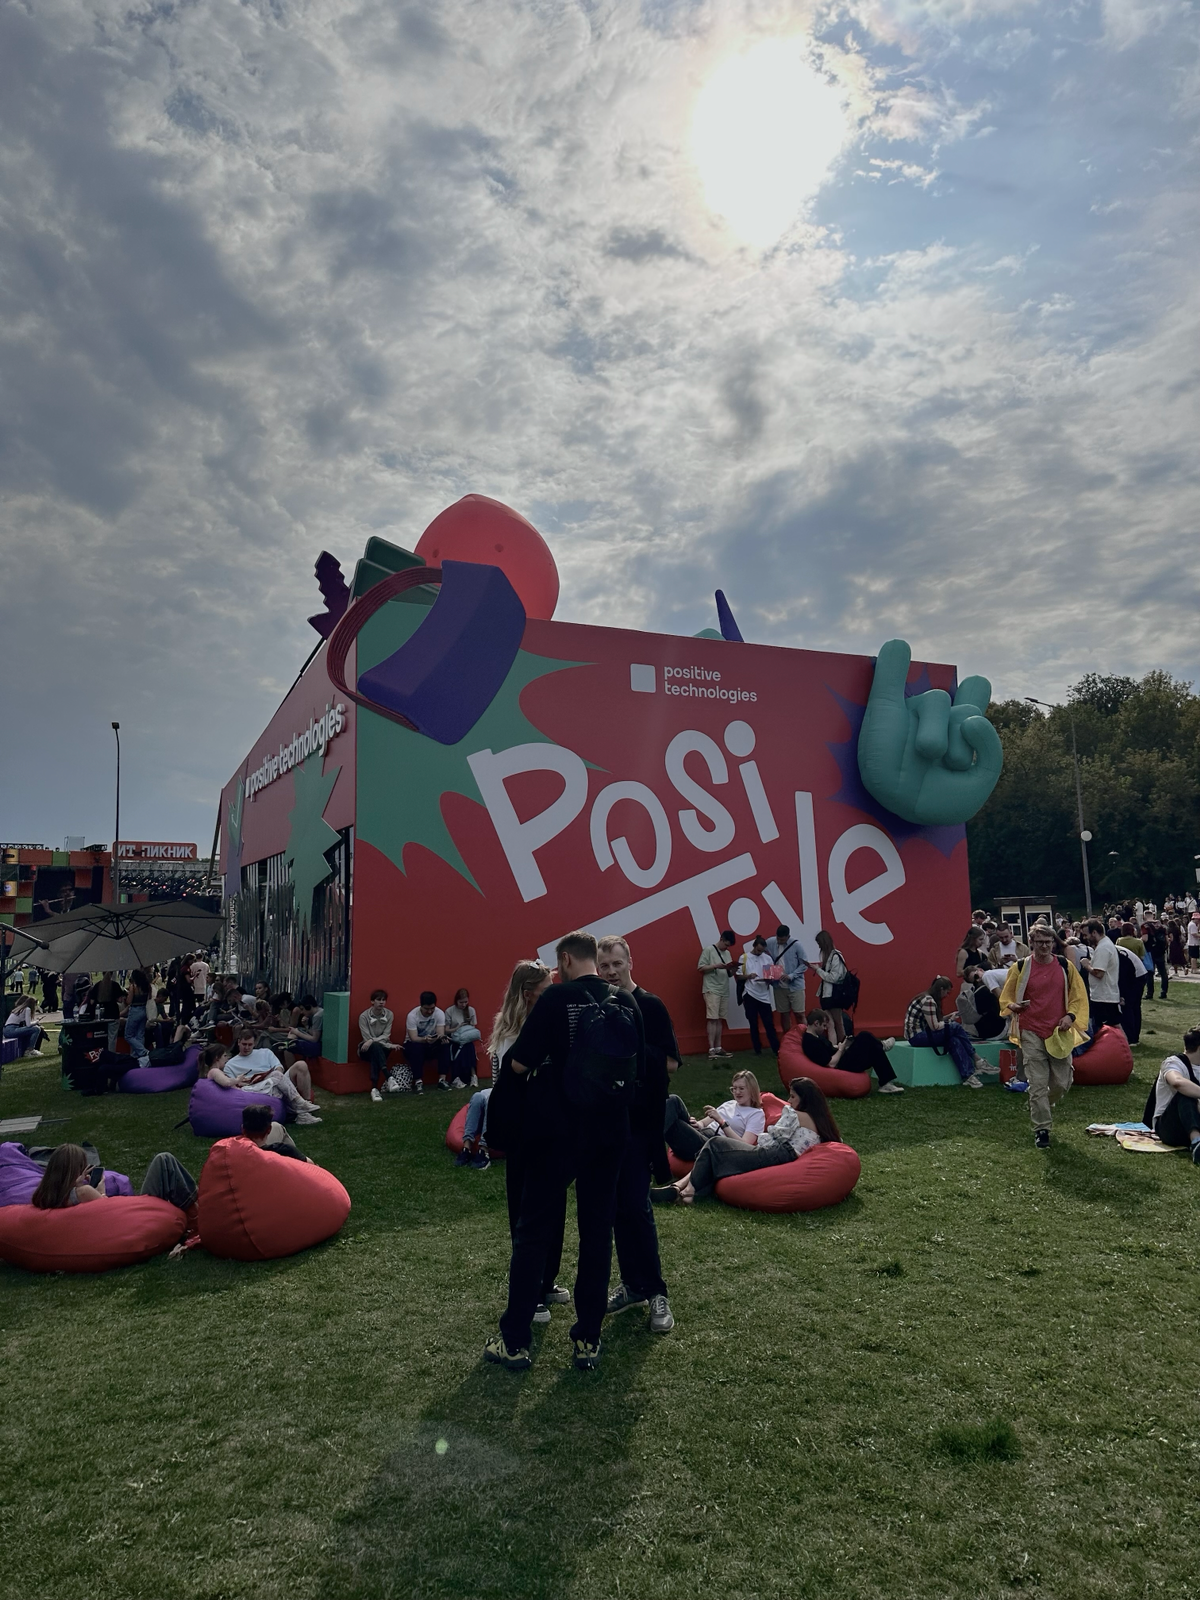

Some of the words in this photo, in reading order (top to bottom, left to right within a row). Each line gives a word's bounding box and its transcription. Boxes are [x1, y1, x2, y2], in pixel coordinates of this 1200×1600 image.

[664, 665, 721, 681] positive
[664, 680, 758, 704] technologies
[249, 753, 281, 802] positive
[279, 703, 346, 775] technologies
